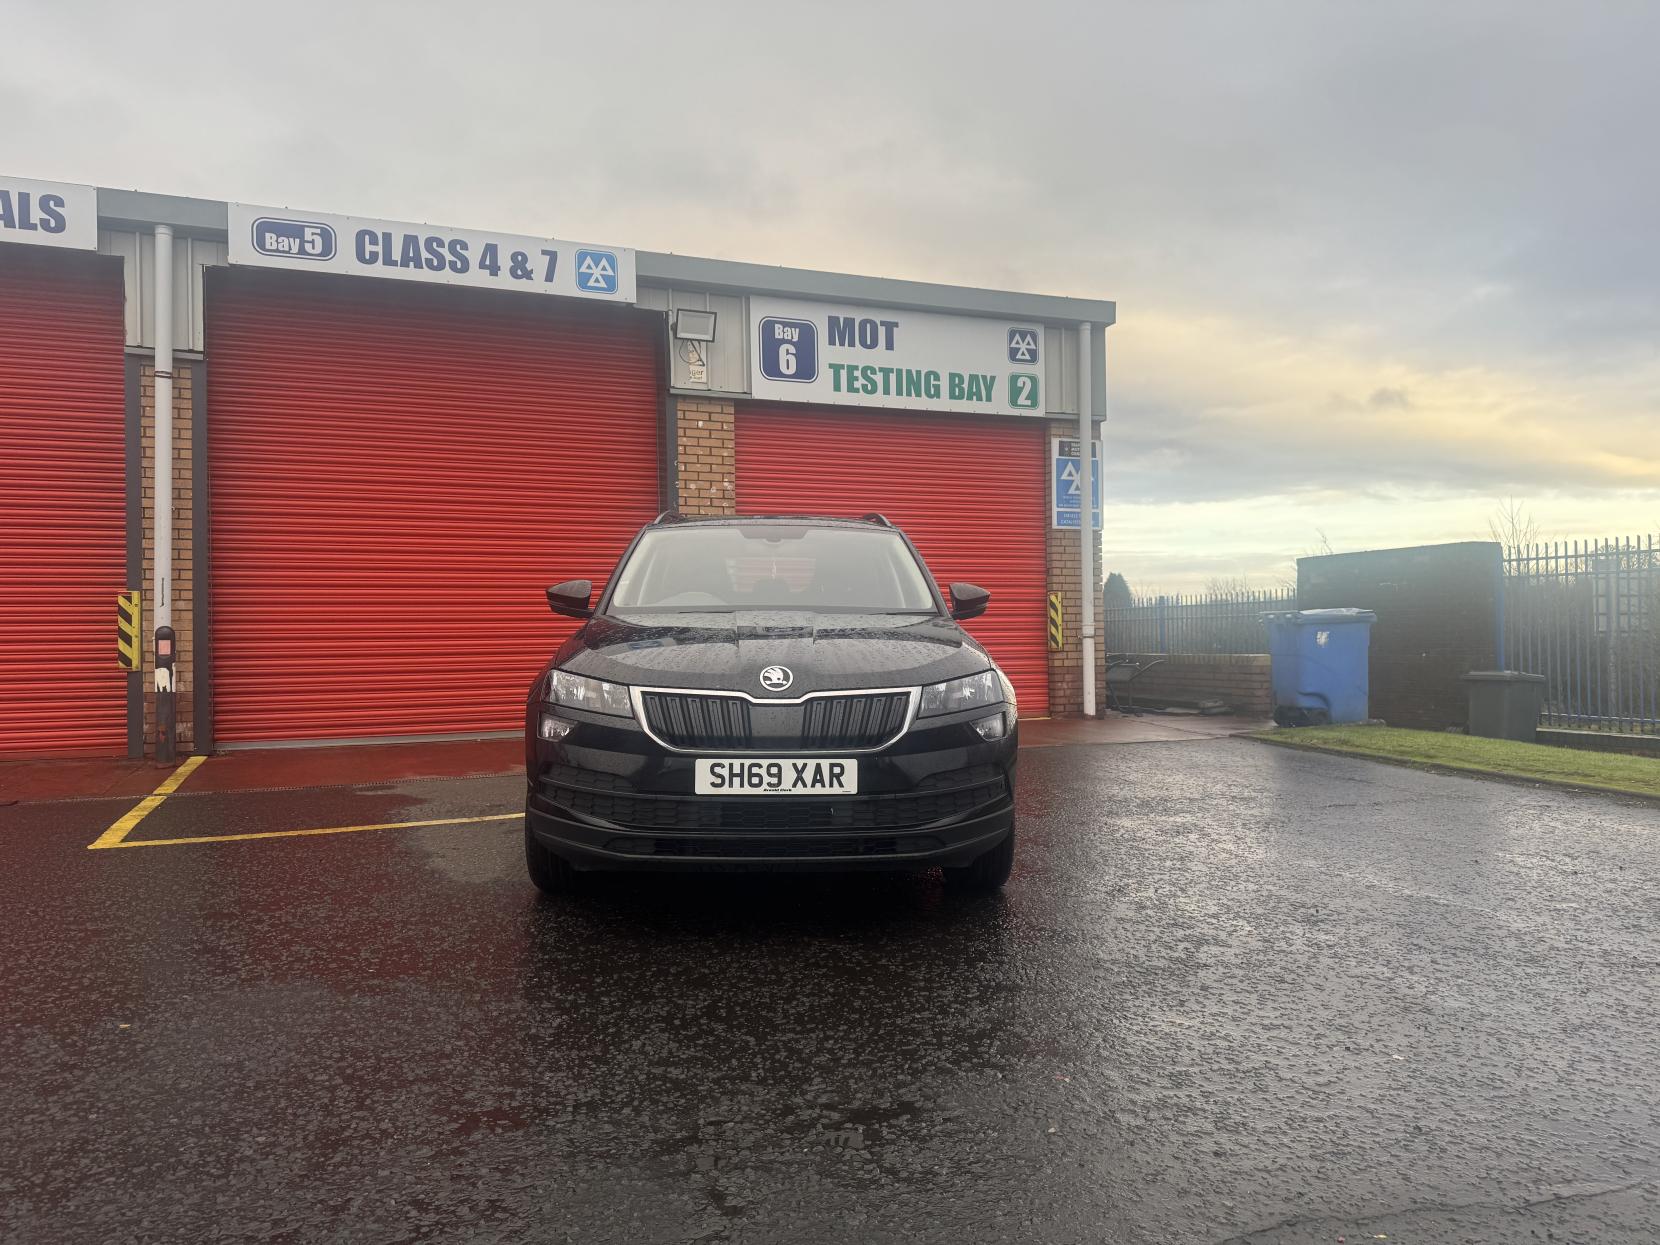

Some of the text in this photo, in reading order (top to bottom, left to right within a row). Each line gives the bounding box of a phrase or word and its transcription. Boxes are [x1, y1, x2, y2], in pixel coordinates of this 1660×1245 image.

[265, 227, 323, 255] Bay 5
[355, 229, 558, 283] CLASS 4 & 7
[775, 322, 799, 342] Bay
[828, 316, 898, 351] MOT
[779, 344, 796, 375] 6
[829, 363, 996, 402] TESTING BAY
[1017, 377, 1032, 405] 2
[710, 763, 845, 788] SH69 XAR
